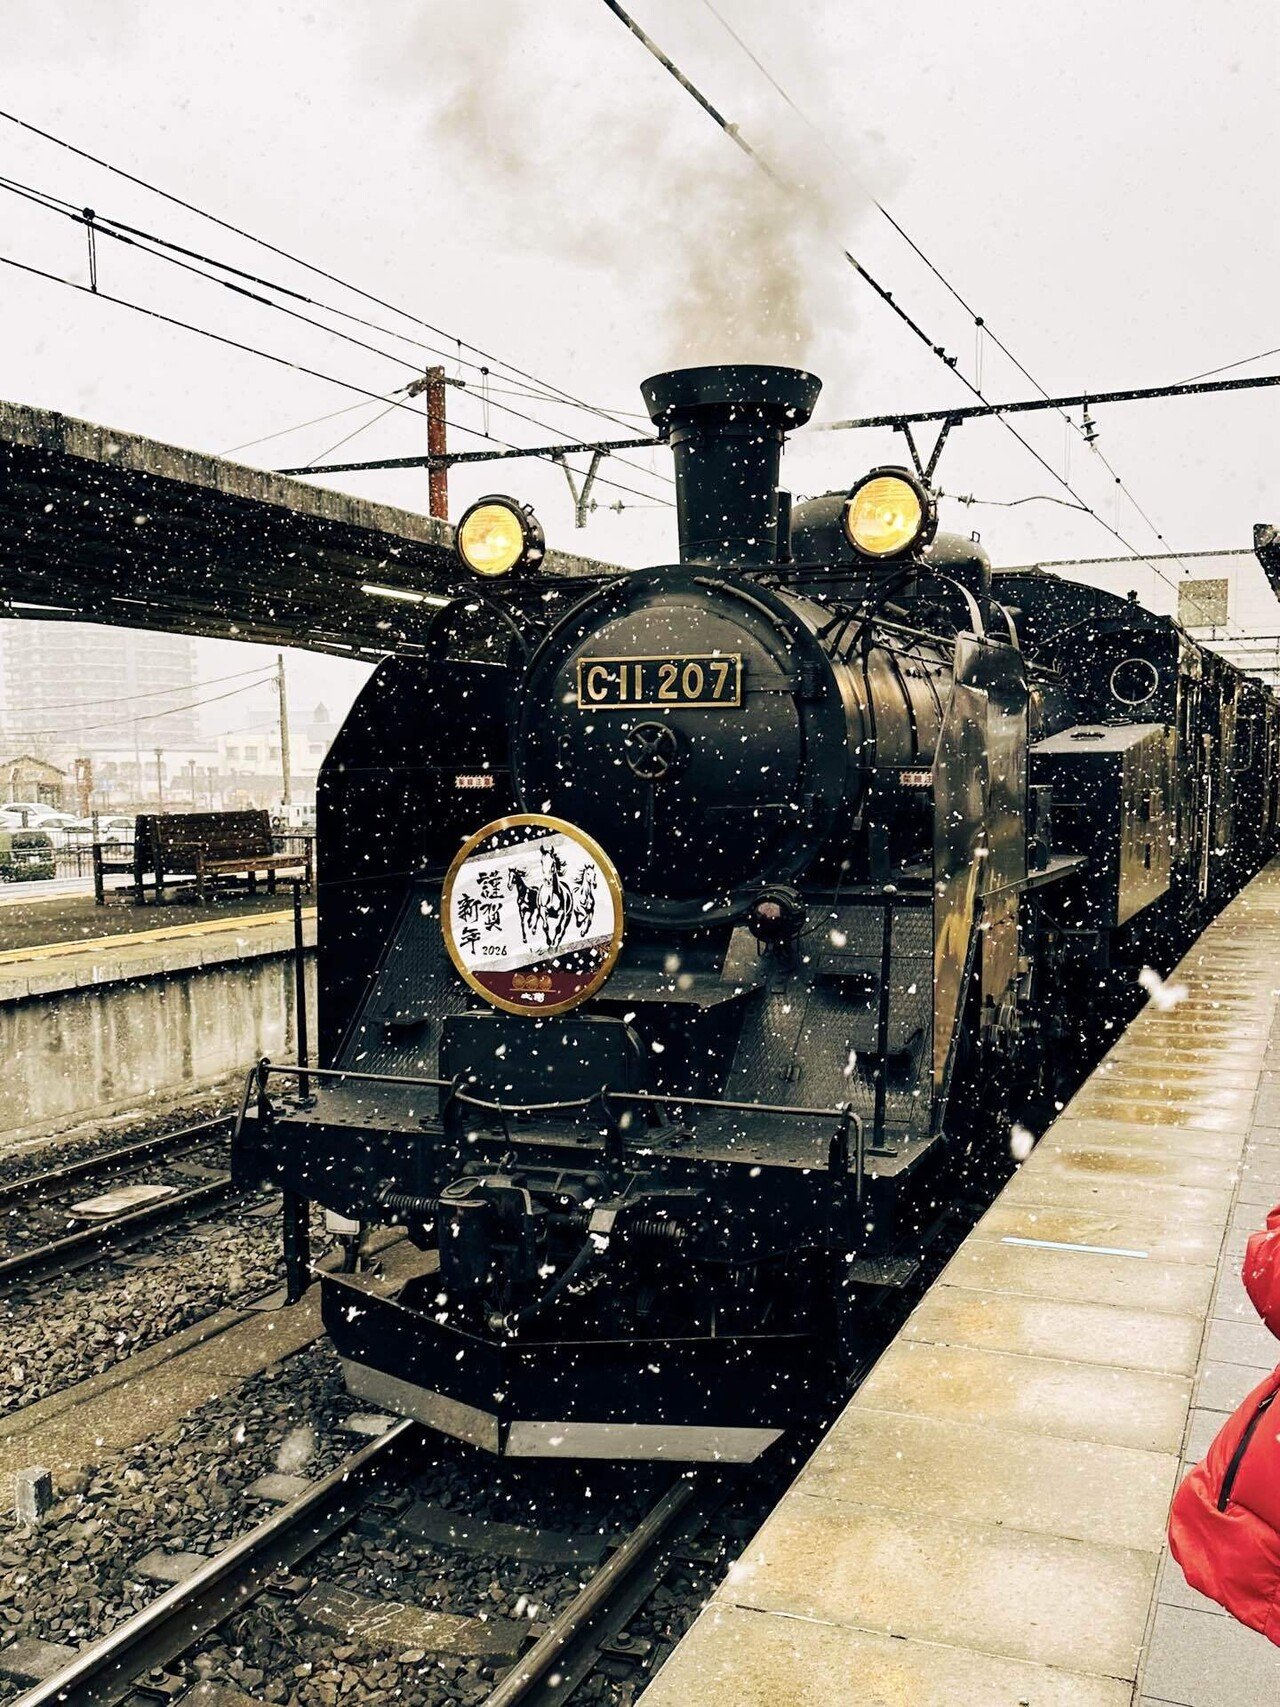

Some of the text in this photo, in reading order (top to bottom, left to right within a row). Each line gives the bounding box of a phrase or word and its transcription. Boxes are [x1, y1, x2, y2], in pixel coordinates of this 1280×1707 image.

[587, 662, 729, 700] C11 207
[457, 893, 482, 955] 新年
[476, 870, 504, 931] 謹賀
[482, 945, 508, 956] 2026
